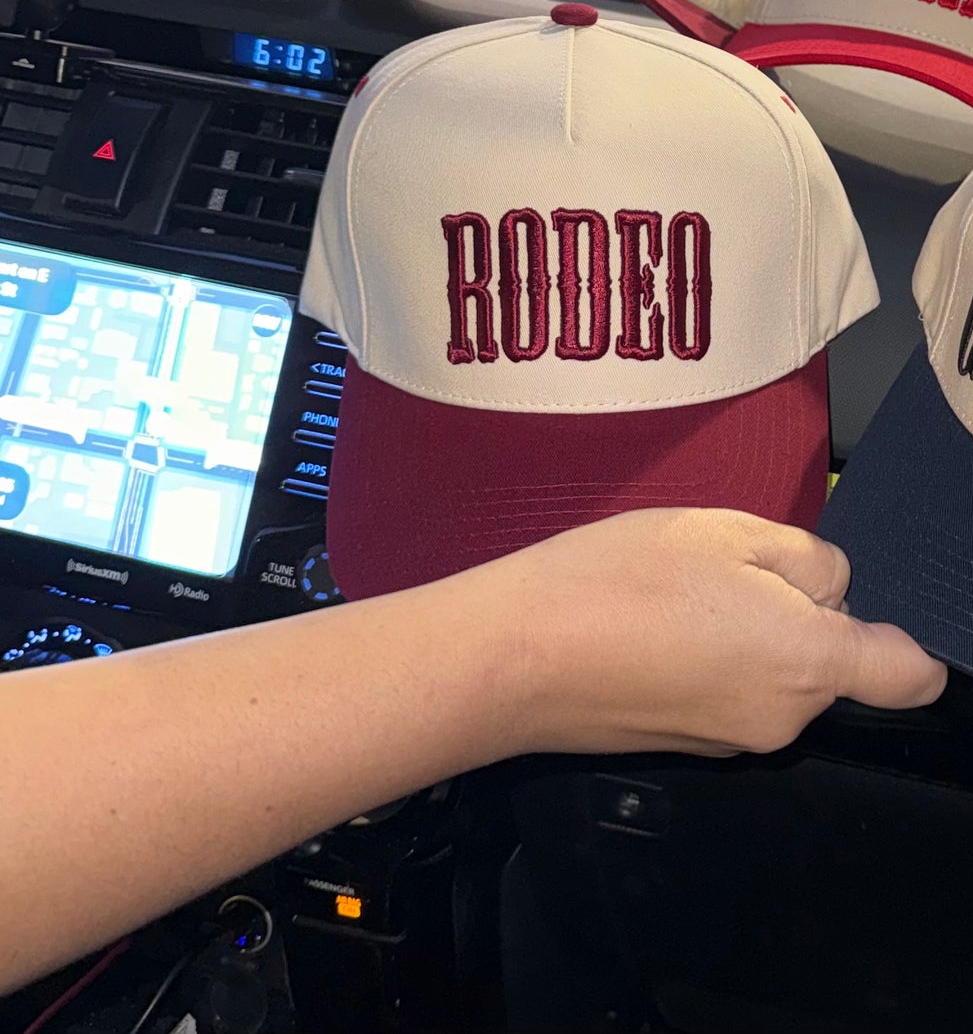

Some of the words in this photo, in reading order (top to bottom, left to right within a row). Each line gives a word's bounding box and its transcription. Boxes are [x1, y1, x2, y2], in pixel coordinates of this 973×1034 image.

[253, 38, 326, 75] 6:02
[441, 207, 712, 364] RODEO
[296, 462, 327, 477] APPS
[269, 562, 295, 575] TUNE
[261, 572, 297, 588] SCROLL
[185, 586, 210, 602] Radio
